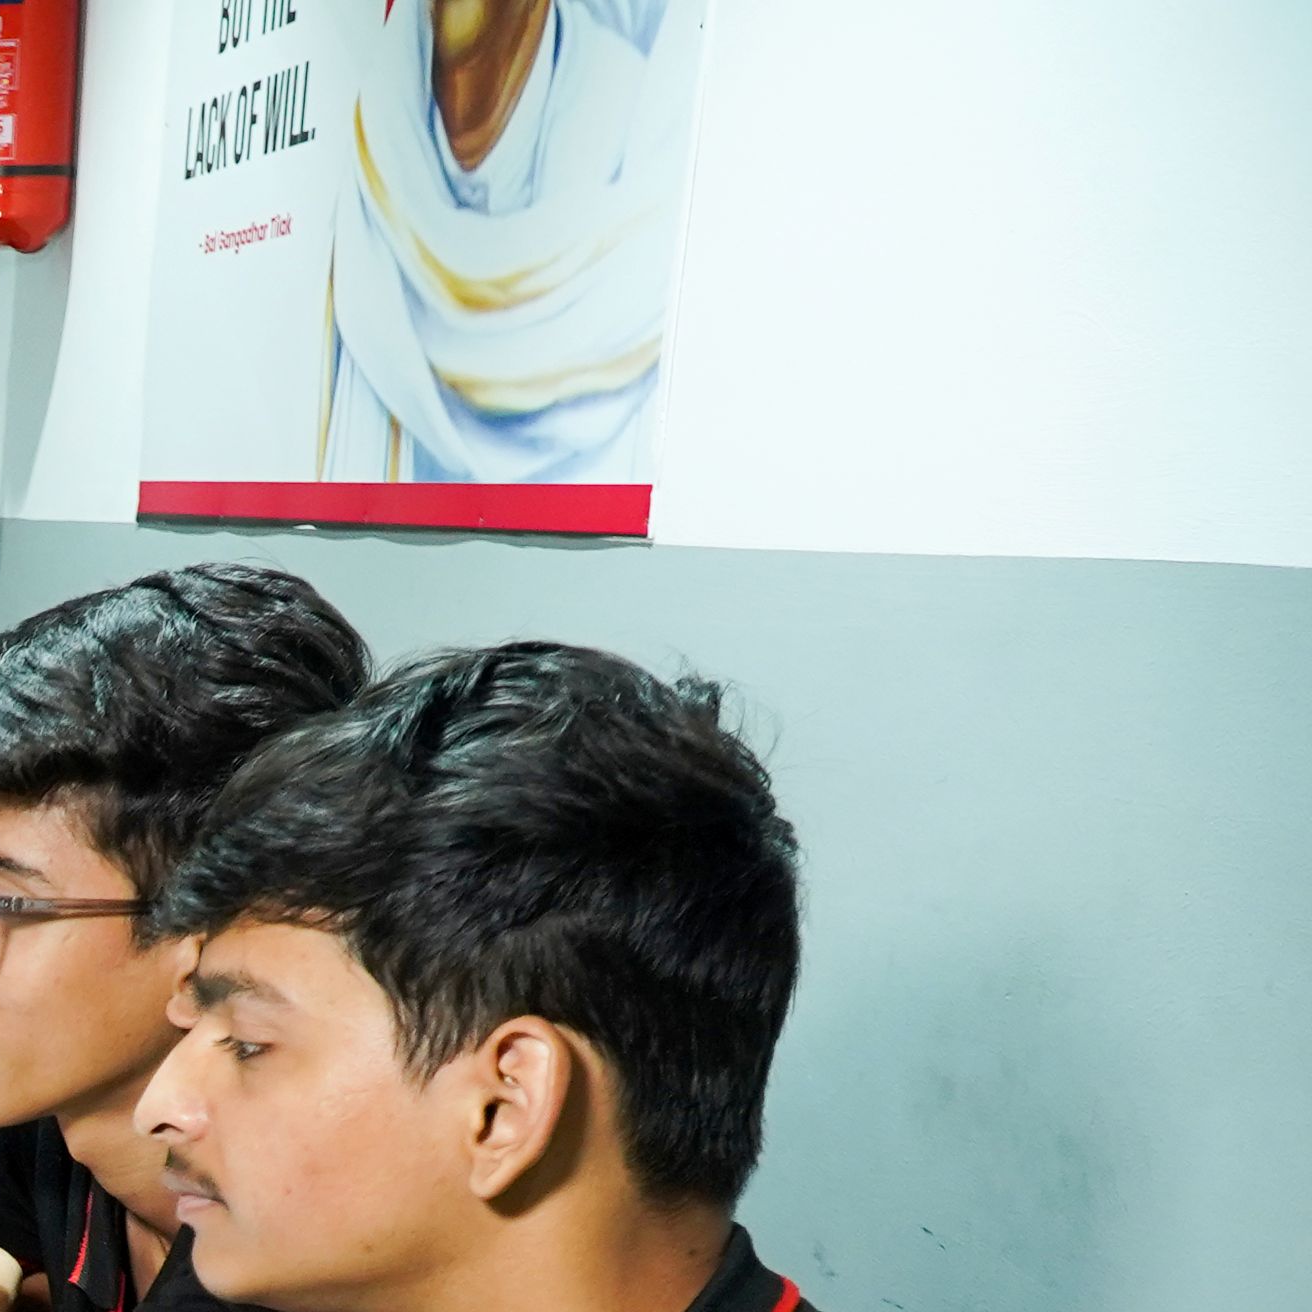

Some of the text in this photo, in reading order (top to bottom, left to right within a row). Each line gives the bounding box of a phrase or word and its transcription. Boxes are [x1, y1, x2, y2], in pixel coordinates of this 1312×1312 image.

[185, 60, 316, 180] LACK OF WILL.
